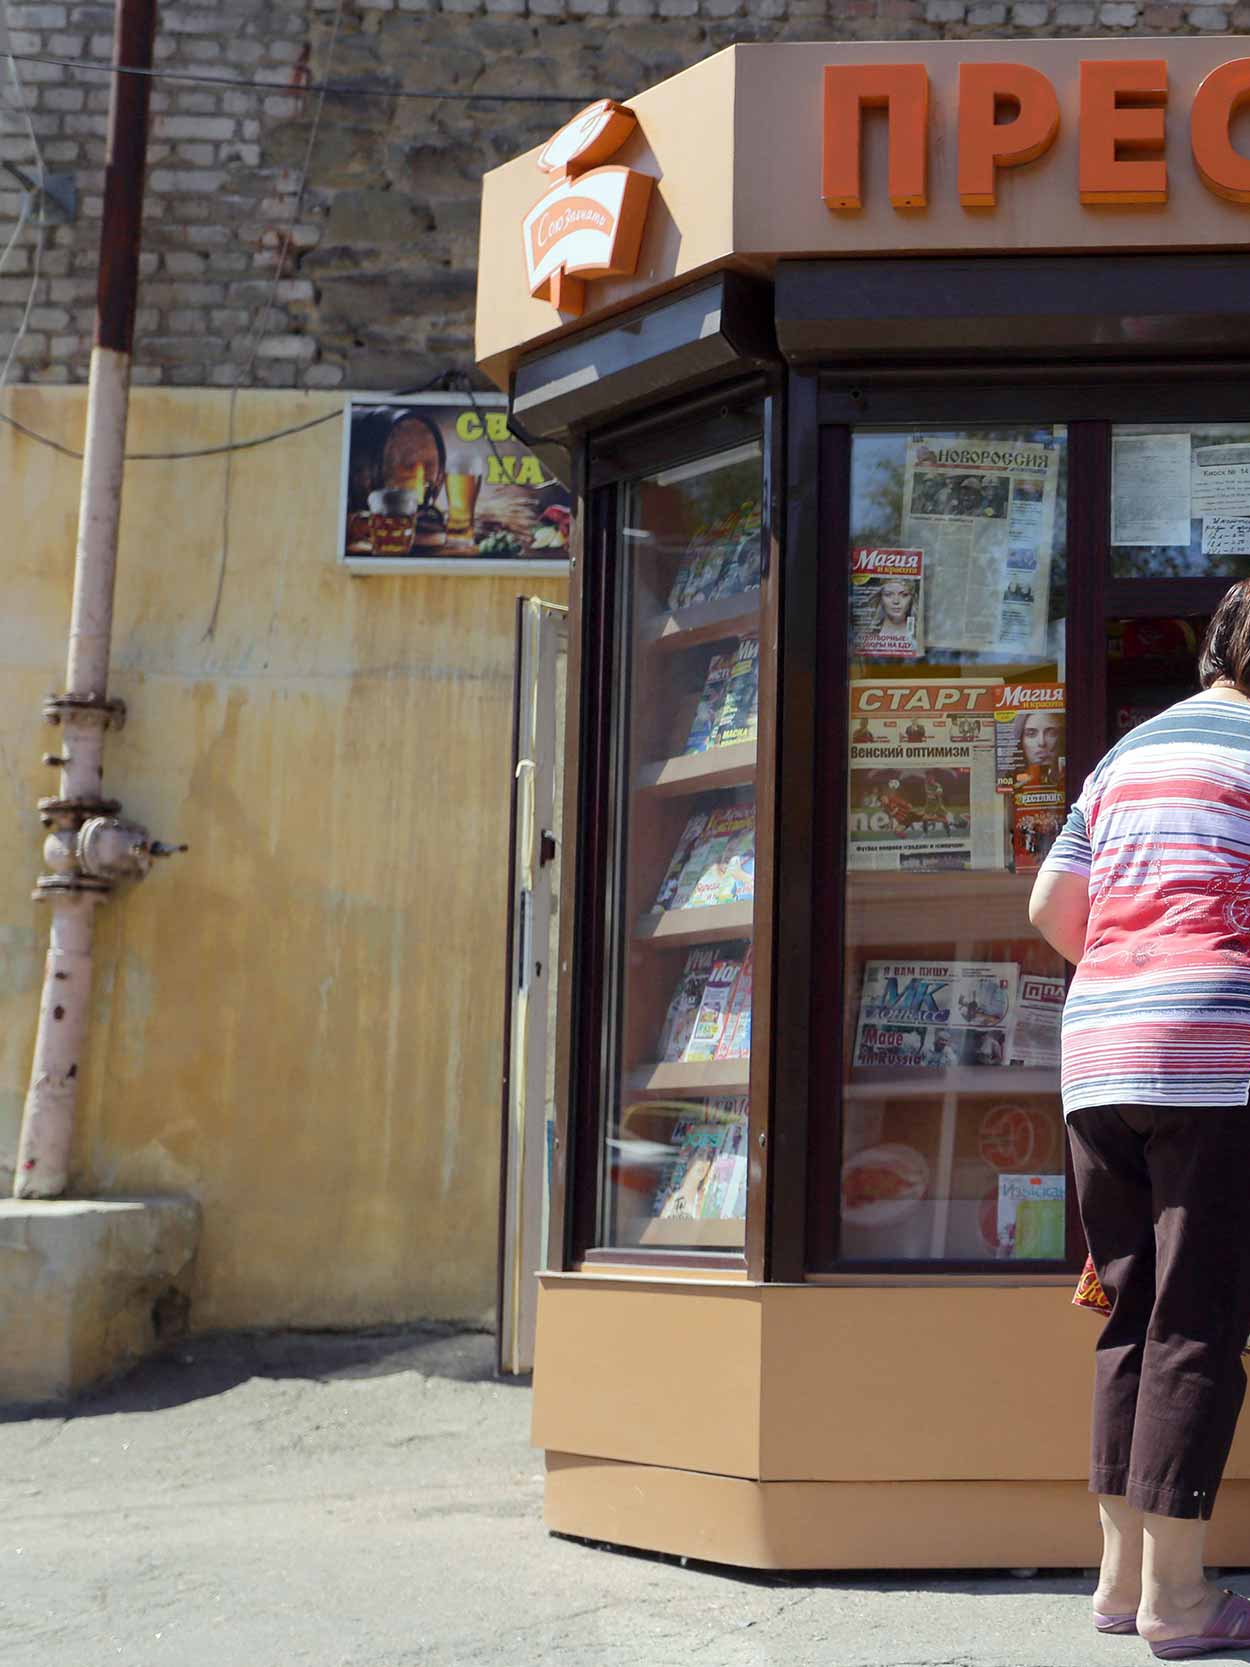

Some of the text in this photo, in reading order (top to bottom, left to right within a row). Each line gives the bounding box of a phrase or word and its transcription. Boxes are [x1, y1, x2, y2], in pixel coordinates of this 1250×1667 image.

[456, 411, 518, 442] СВ
[938, 448, 1049, 469] НОВОРОССИЯ
[854, 550, 919, 570] Магия
[858, 688, 987, 711] СТАРТ
[997, 687, 1064, 708] Магия
[851, 745, 970, 759] Венский оптимизм
[894, 967, 915, 976] ВАМ
[879, 976, 949, 1011] МК
[864, 1028, 904, 1045] Made
